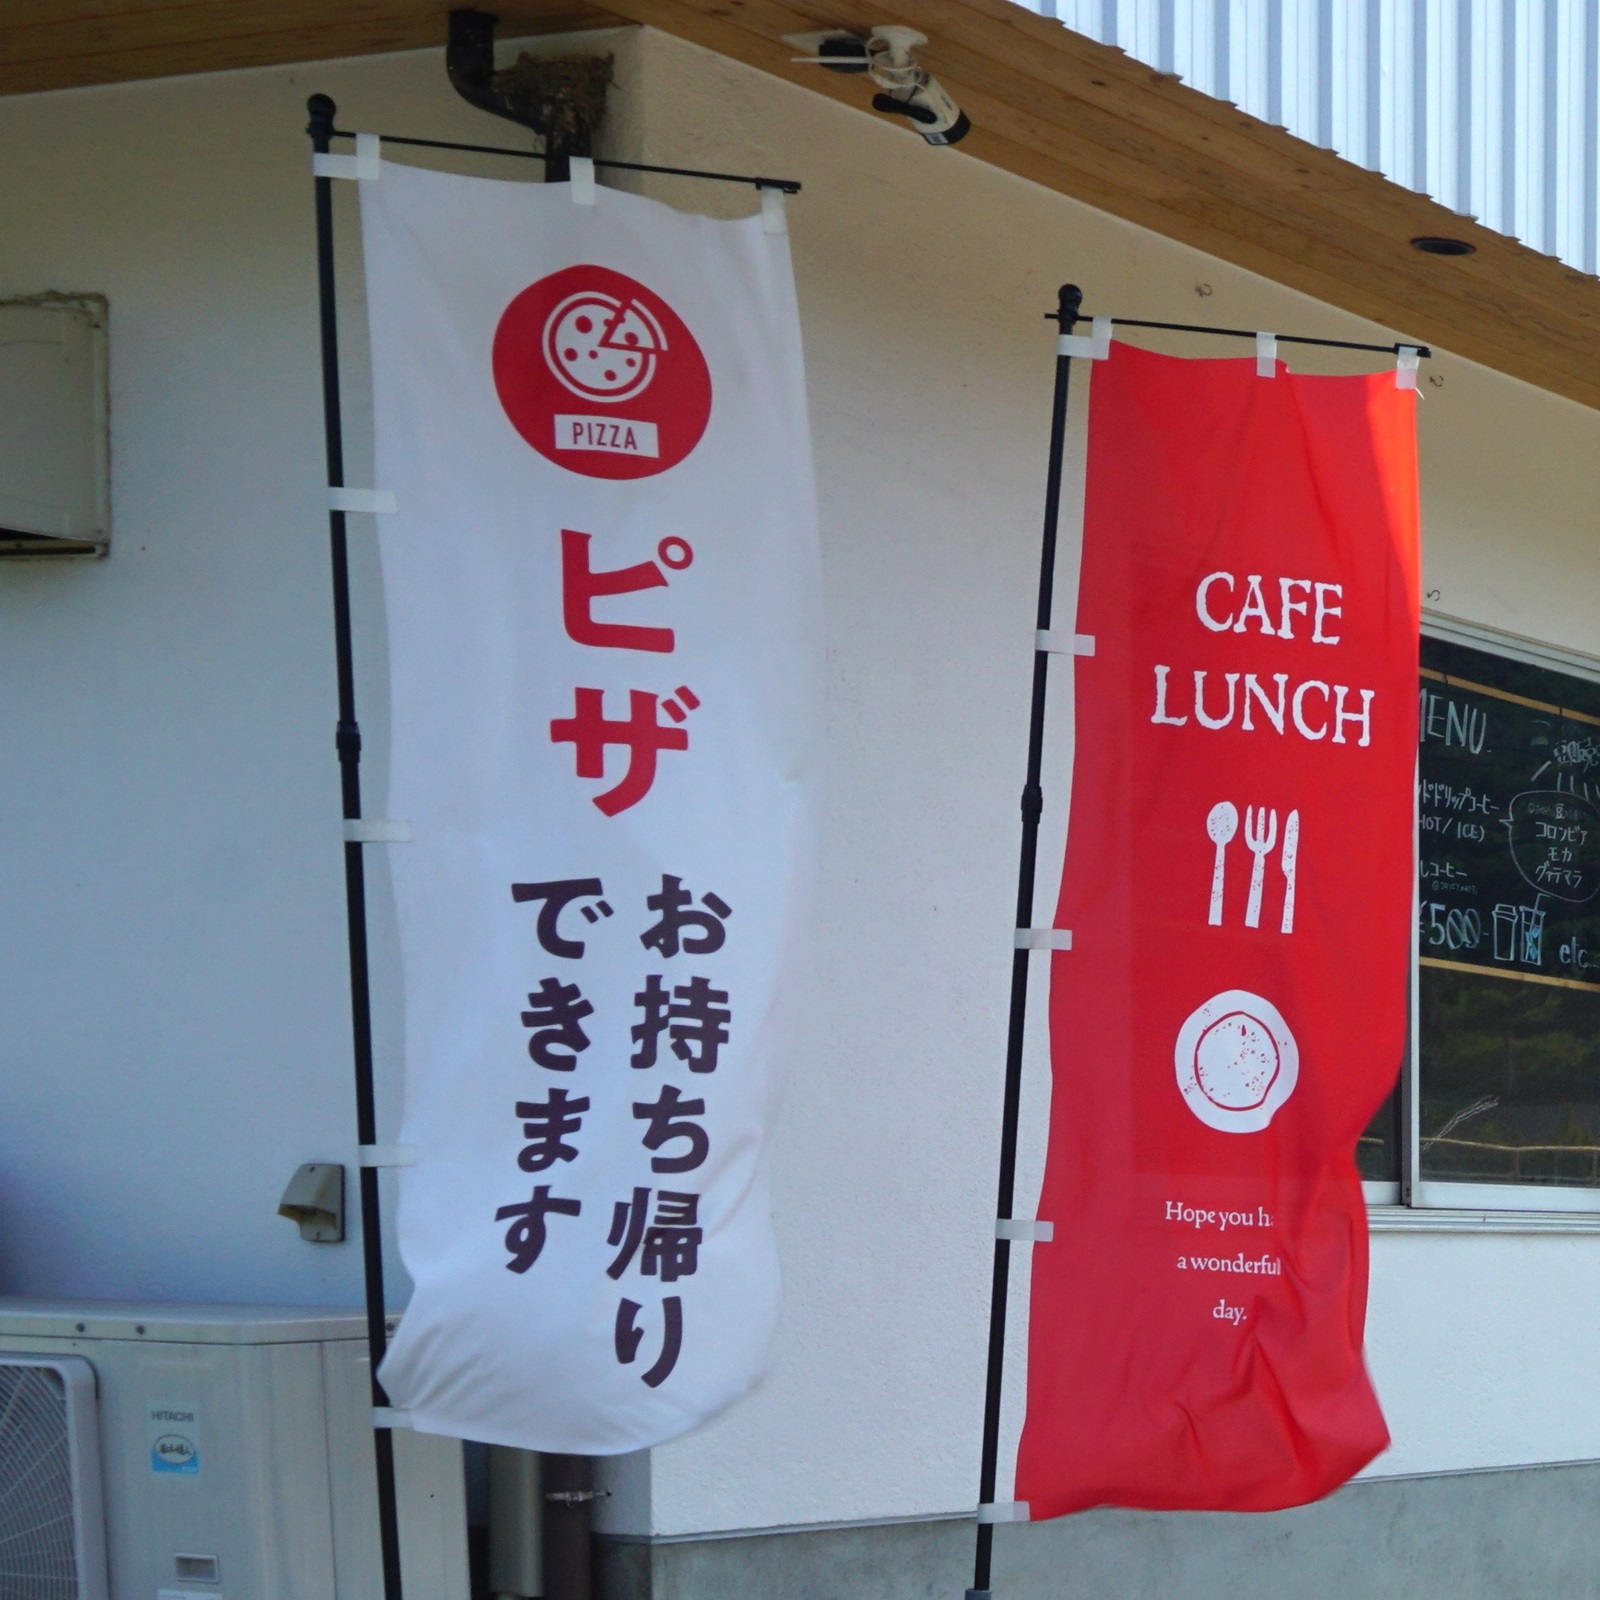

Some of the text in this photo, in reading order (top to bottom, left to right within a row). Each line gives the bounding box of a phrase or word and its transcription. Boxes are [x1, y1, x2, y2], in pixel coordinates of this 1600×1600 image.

[572, 422, 638, 450] PIZZA
[1196, 571, 1343, 646] CAFE
[550, 529, 701, 818] ピザ
[1150, 664, 1376, 748] LUNCH
[1535, 821, 1589, 846] コロンビア
[1547, 846, 1573, 863] モカ
[494, 878, 615, 1275] できます
[606, 873, 733, 1389] お持ち帰り
[1165, 1201, 1216, 1229] Hope
[1218, 1211, 1254, 1231] you
[1177, 1252, 1281, 1275] a wonderful
[1212, 1299, 1247, 1326] day.
[151, 1410, 194, 1422] HITACHI
